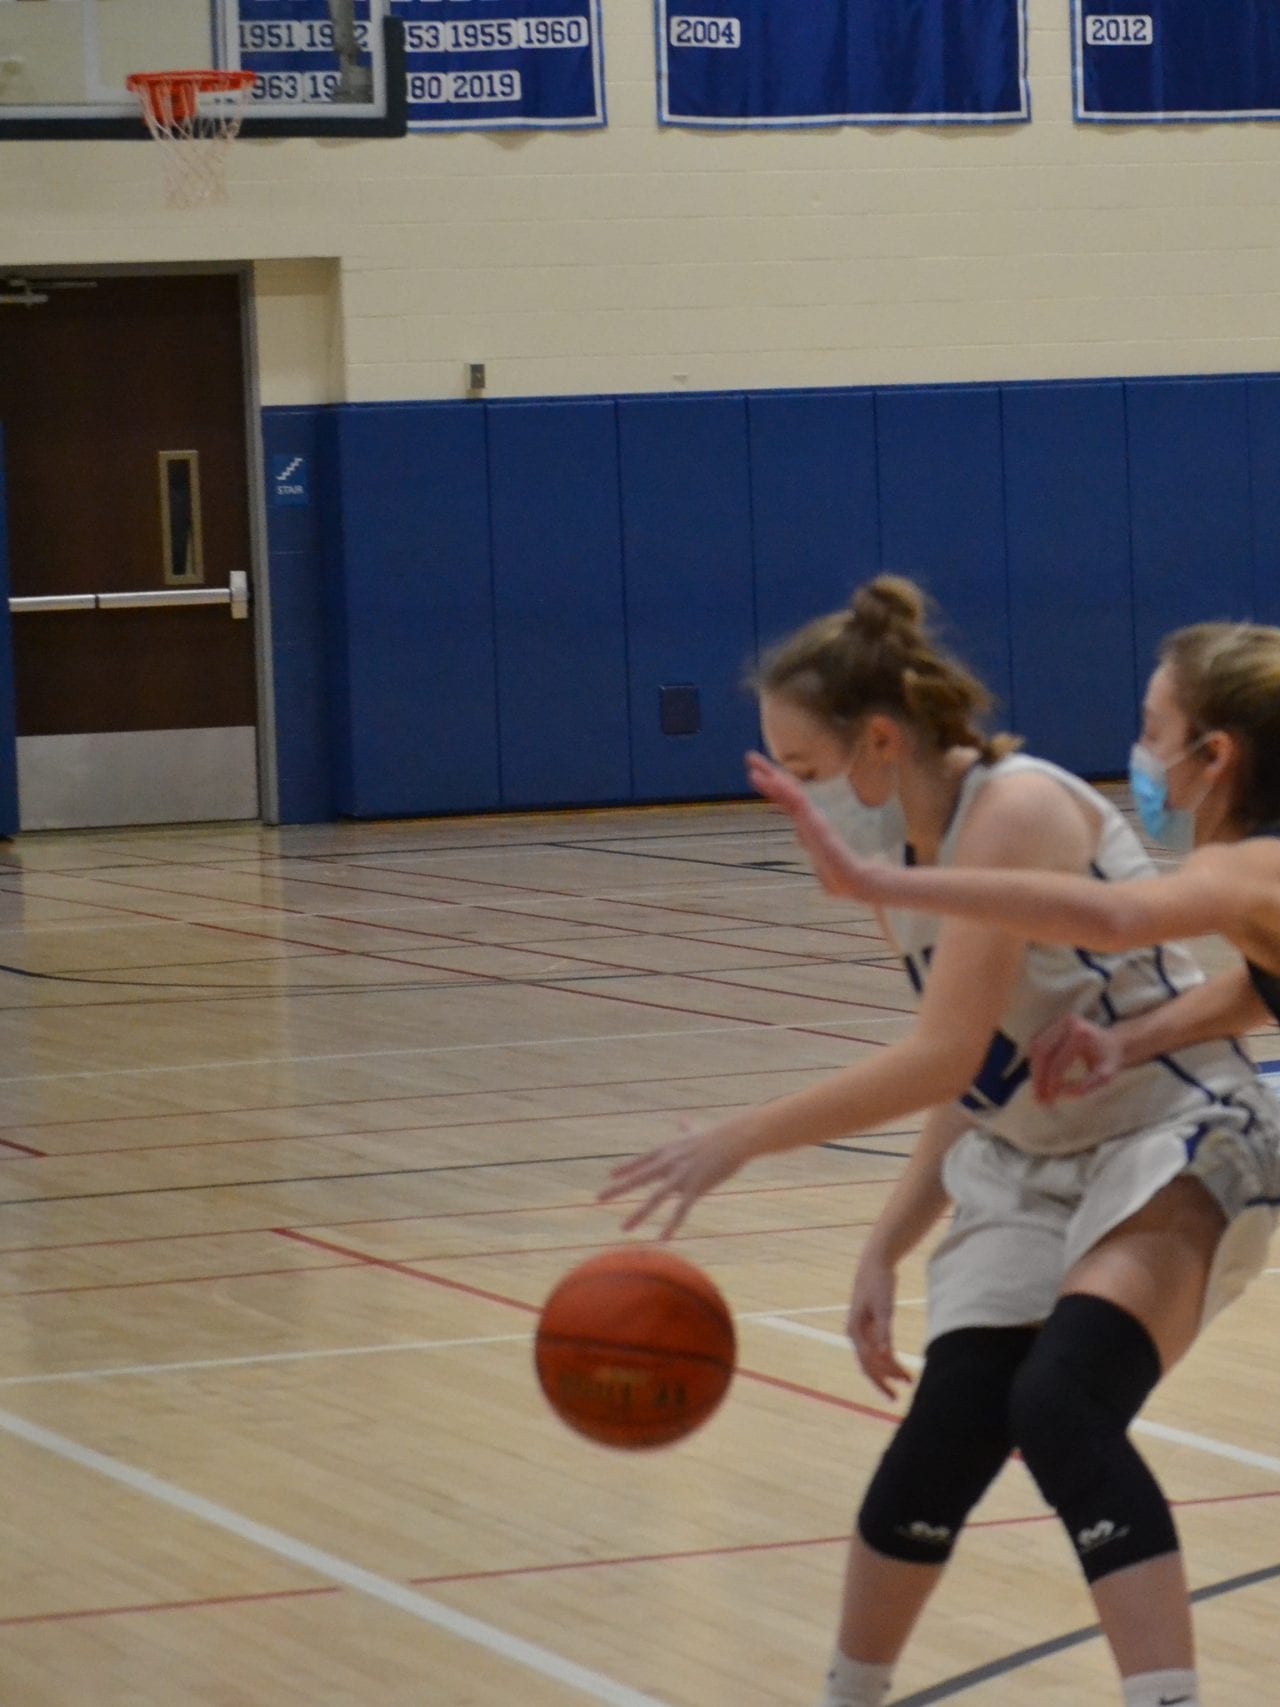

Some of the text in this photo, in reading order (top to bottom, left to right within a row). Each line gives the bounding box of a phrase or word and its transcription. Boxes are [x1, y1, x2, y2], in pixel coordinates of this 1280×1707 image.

[306, 23, 368, 48] 192
[407, 24, 440, 49] 53
[451, 22, 512, 48] 1955
[524, 20, 582, 45] 1960
[676, 19, 734, 44] 2004
[1092, 18, 1147, 41] 2012
[251, 75, 299, 99] 963
[410, 75, 442, 100] 80
[453, 73, 514, 99] 2019
[277, 485, 304, 496] STAIR
